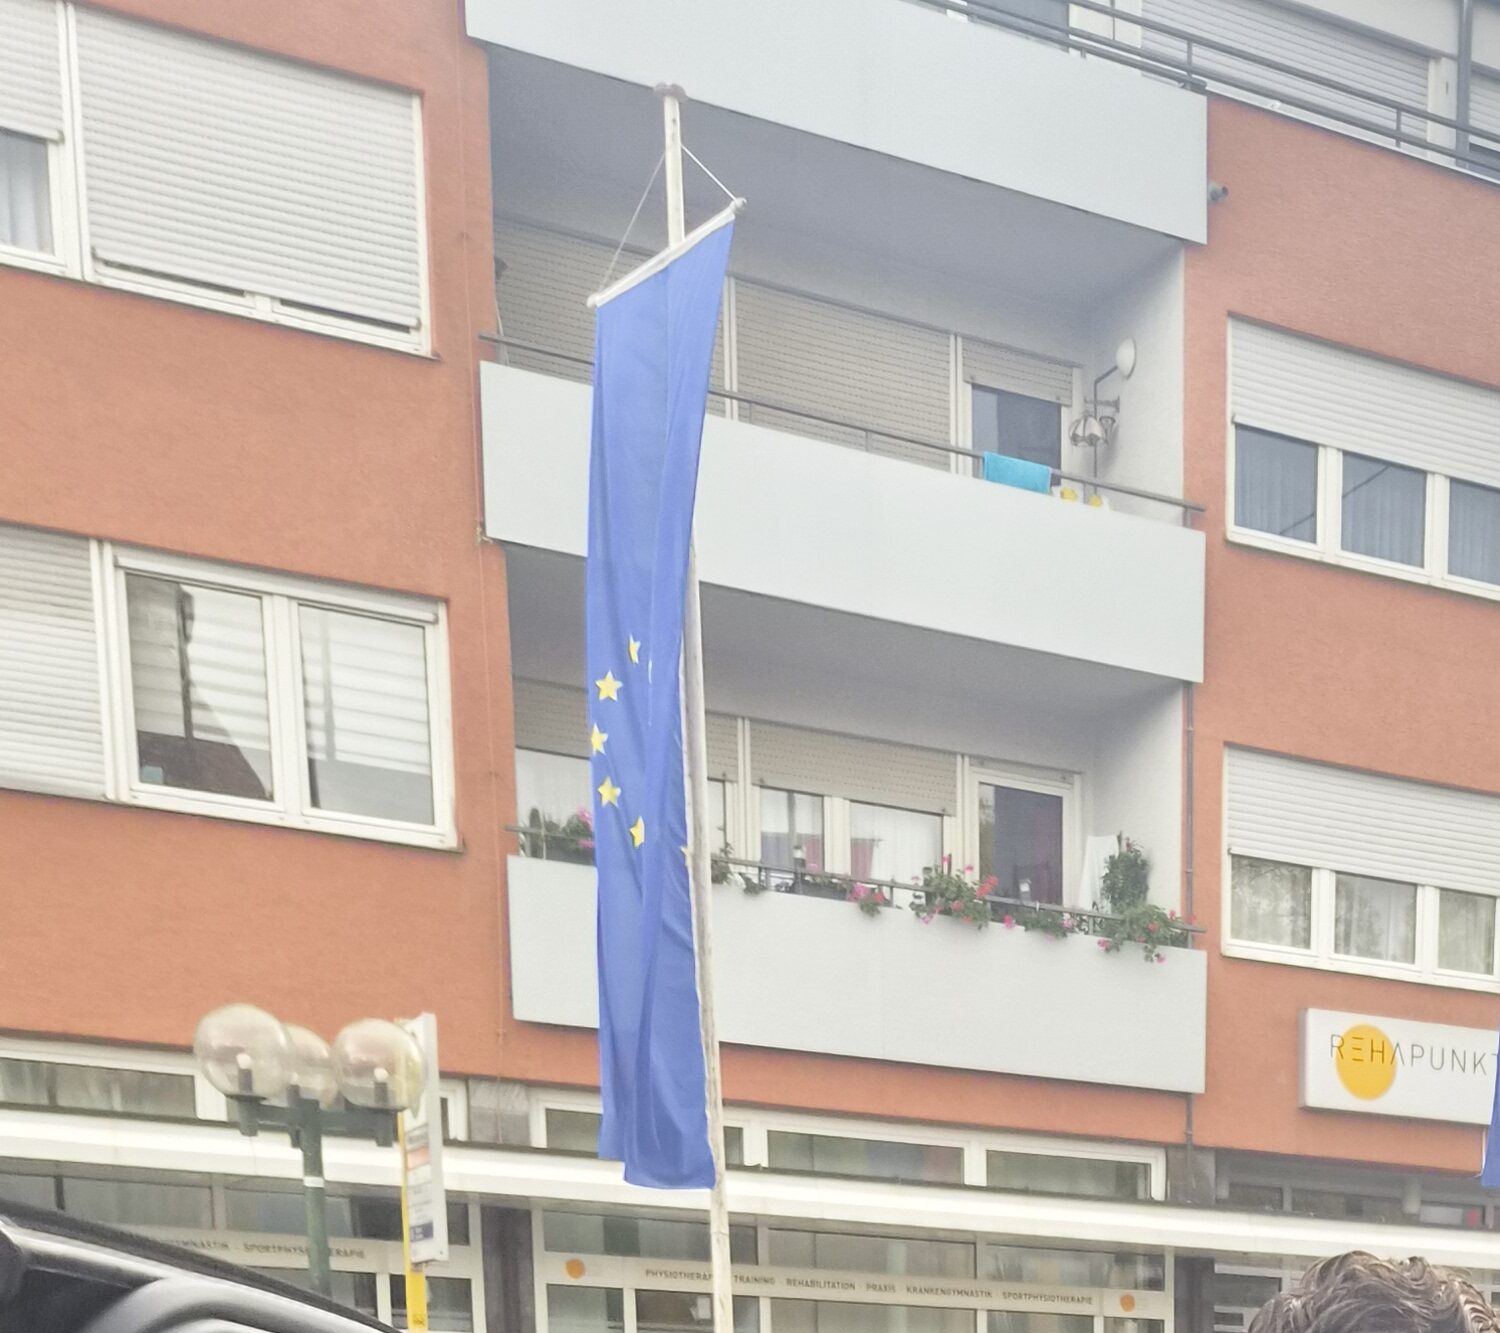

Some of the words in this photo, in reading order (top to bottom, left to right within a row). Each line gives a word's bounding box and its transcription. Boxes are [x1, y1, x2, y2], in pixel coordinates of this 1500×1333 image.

[645, 1269, 713, 1281] PHYSIOTHERAP
[734, 1274, 775, 1285] TRAINING
[786, 1278, 855, 1291] REHABILITATION
[866, 1283, 896, 1293] PRAXIS
[906, 1286, 992, 1298] KRANKENGYMNASTIK
[1002, 1291, 1093, 1305] SPORTPHYSIOTHERAPIE
